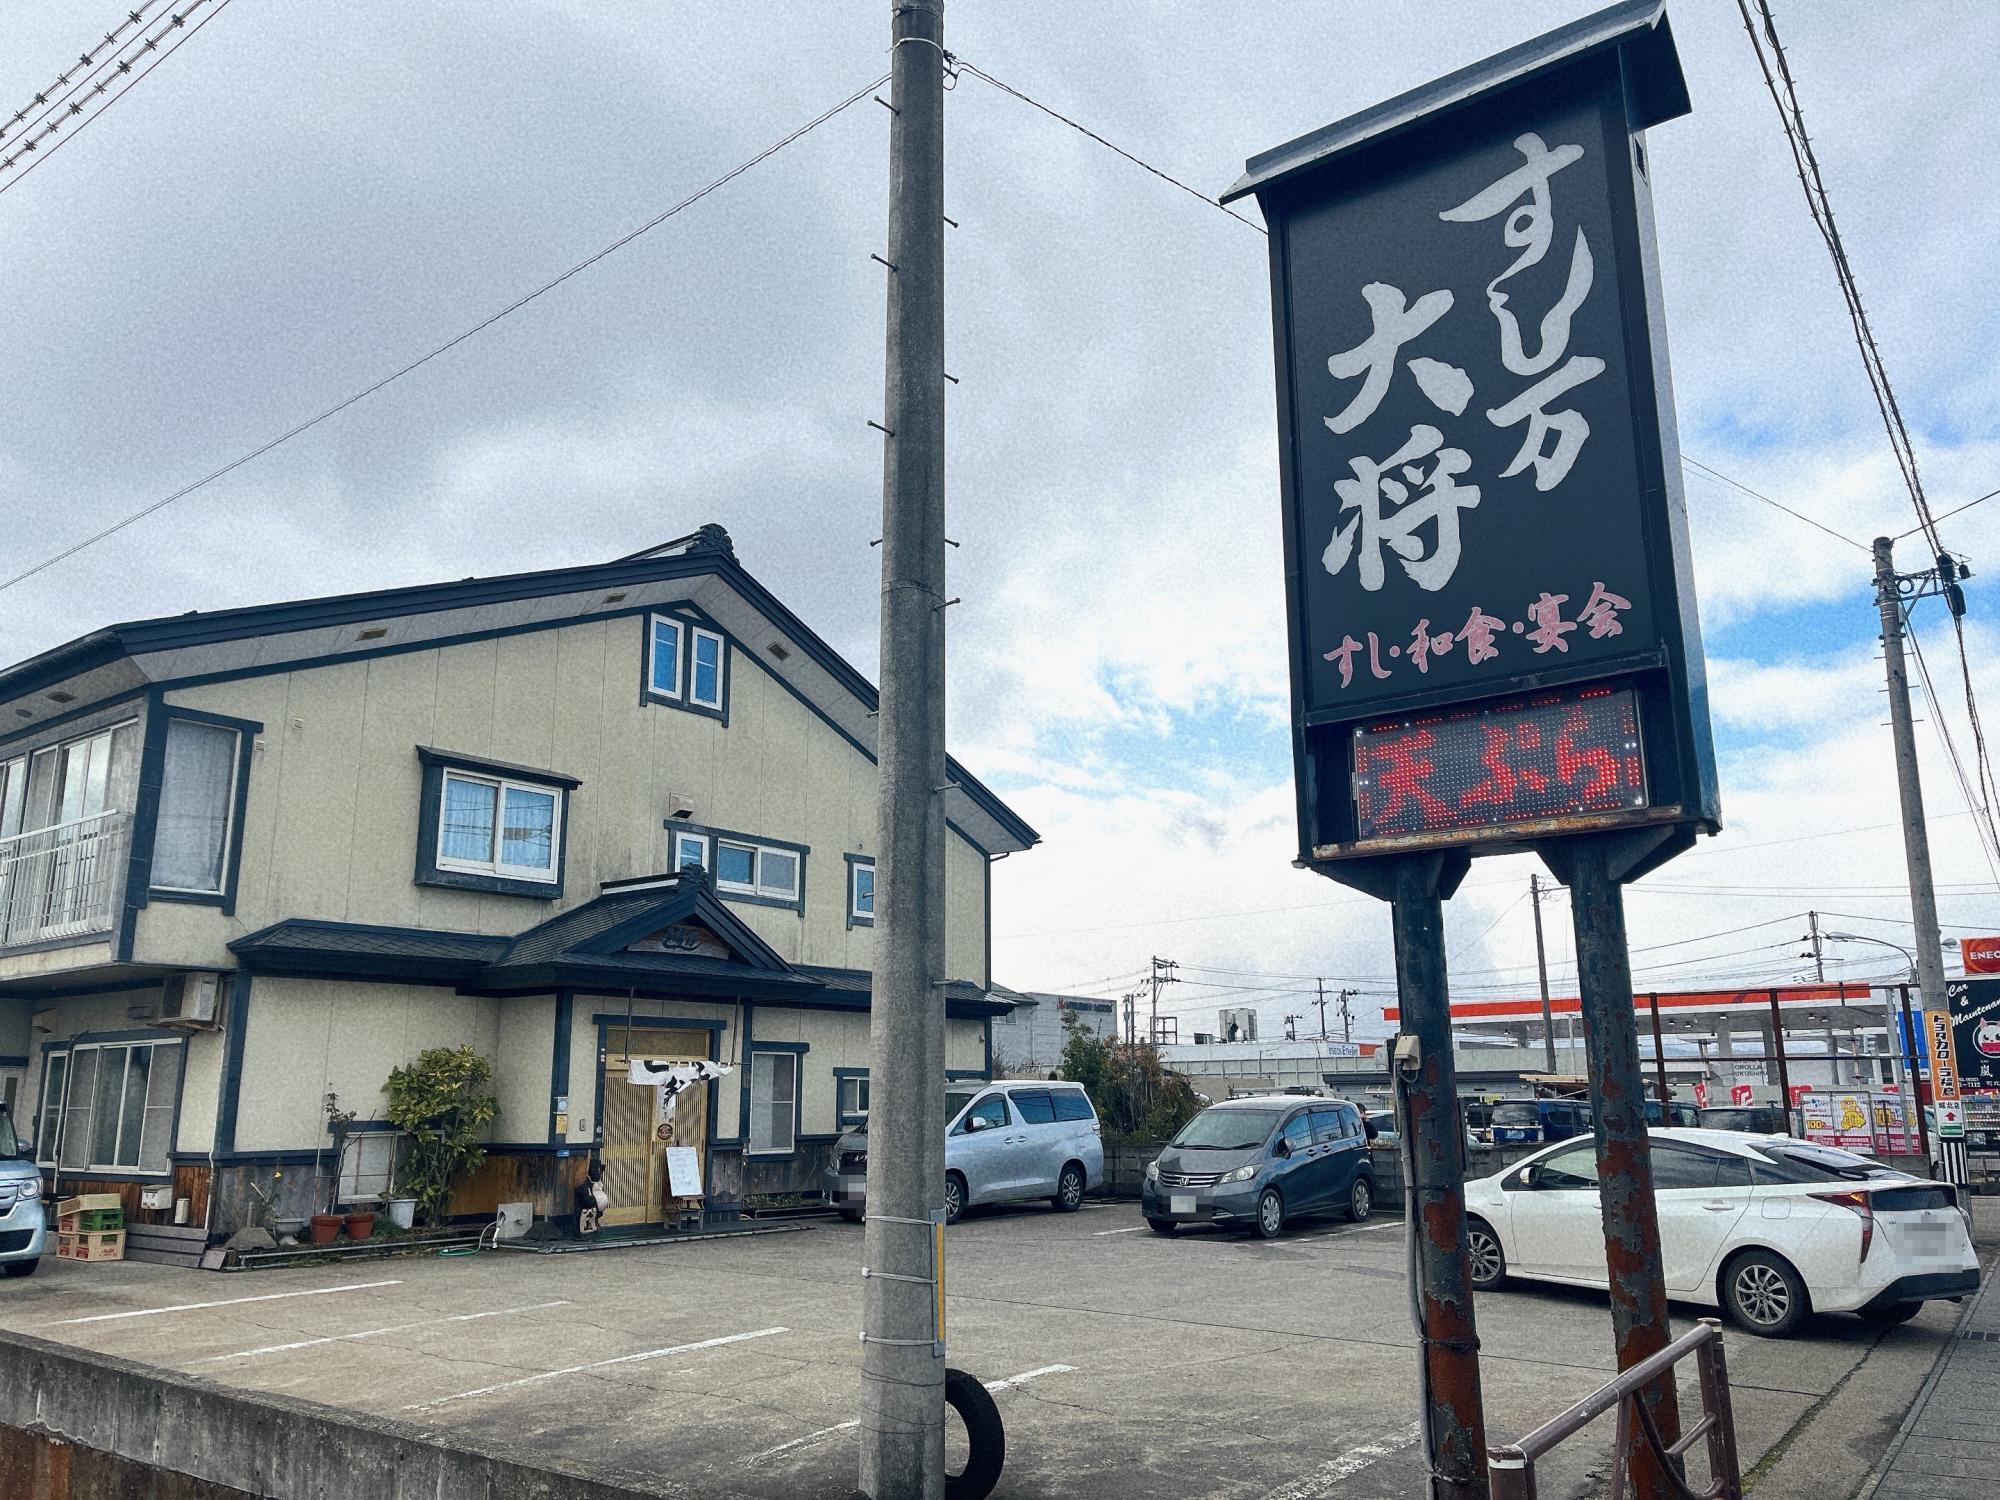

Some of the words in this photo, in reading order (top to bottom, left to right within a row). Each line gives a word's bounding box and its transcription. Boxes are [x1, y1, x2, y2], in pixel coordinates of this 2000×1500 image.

[1439, 132, 1606, 492] すし万
[1322, 281, 1481, 592] 大将
[1370, 703, 1621, 830] 天ぷら
[1948, 983, 1969, 997] Car
[1960, 995, 1969, 1006] &
